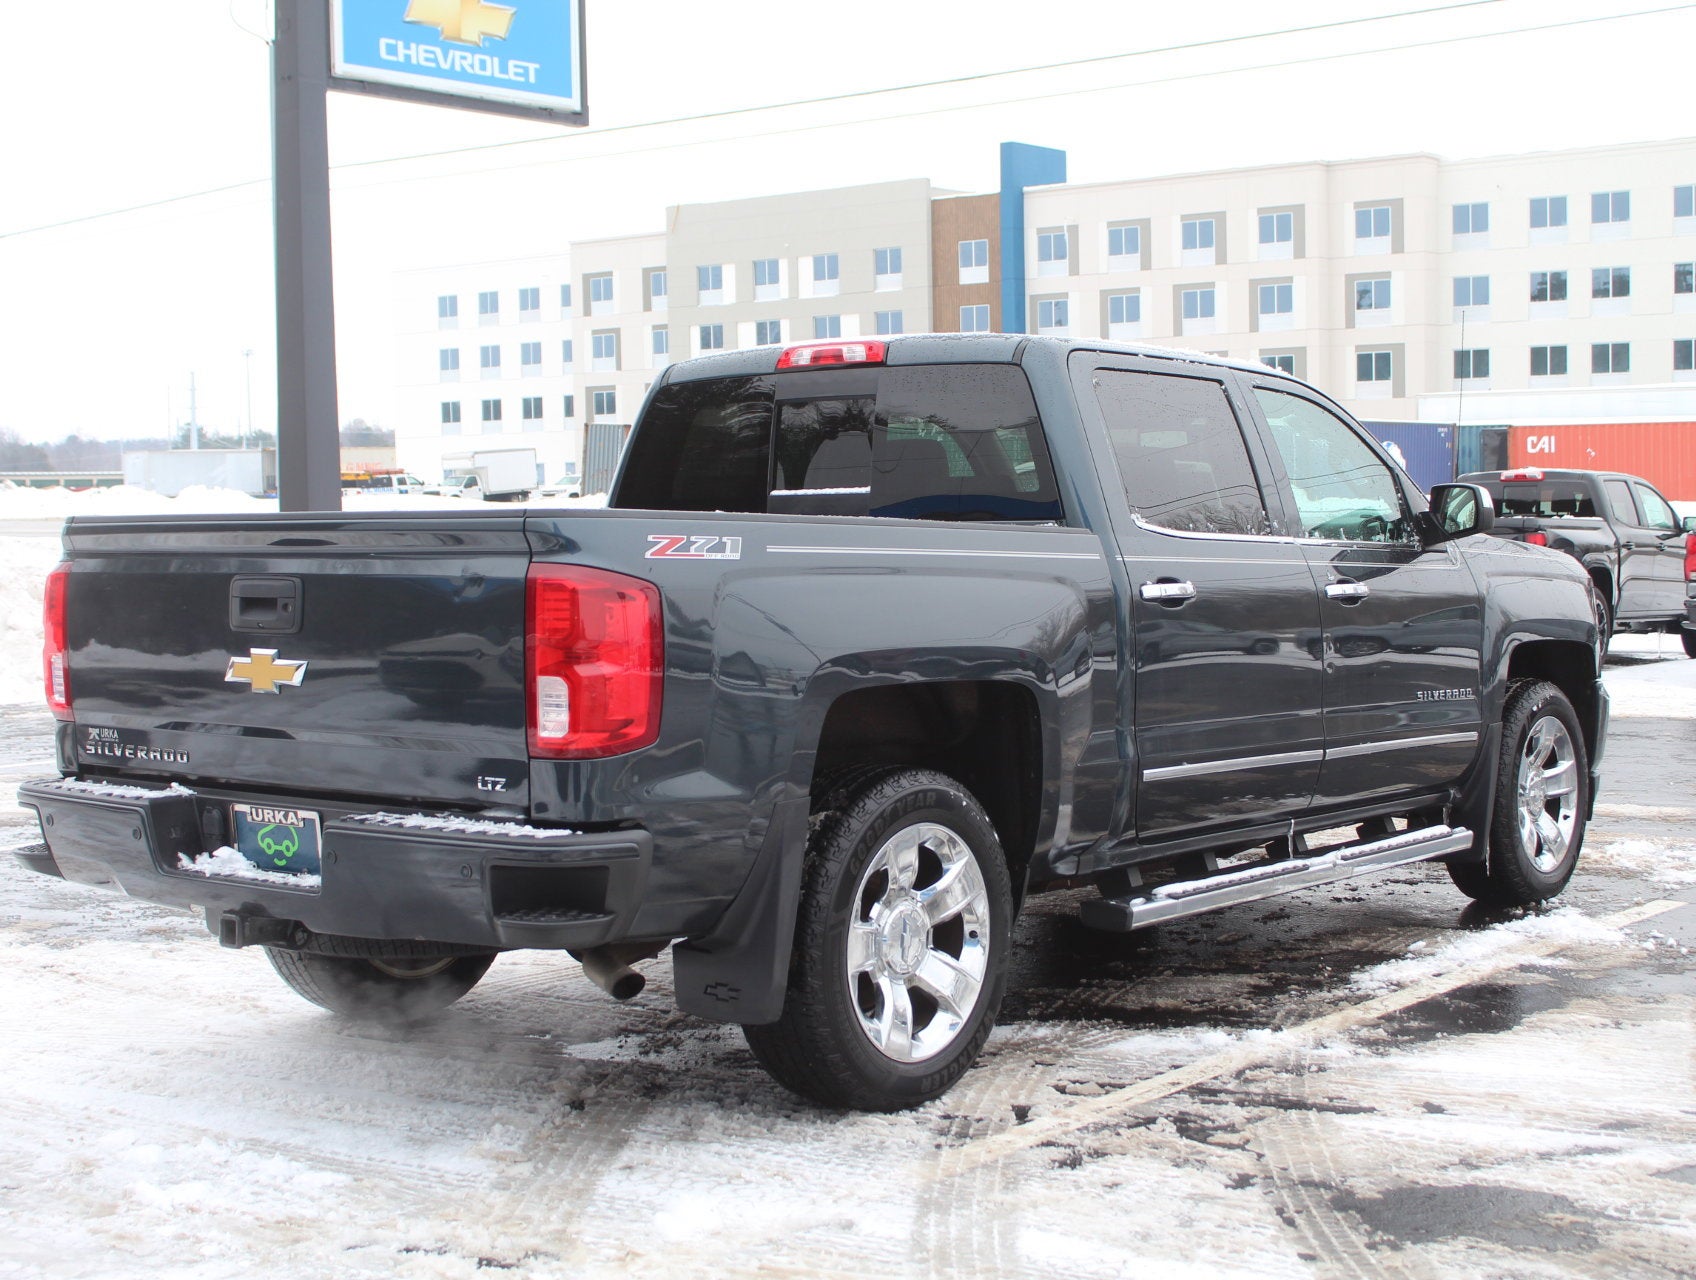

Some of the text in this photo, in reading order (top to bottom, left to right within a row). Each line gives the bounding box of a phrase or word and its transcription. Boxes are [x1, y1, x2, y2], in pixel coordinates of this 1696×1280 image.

[378, 37, 540, 84] CHEVROLET
[1526, 435, 1556, 454] CAI
[644, 534, 742, 560] Z71
[1416, 688, 1472, 701] SILVERADO
[100, 728, 119, 739] URKA
[85, 740, 190, 763] SILVERADO
[477, 775, 507, 792] LTZ
[251, 807, 299, 825] URKA
